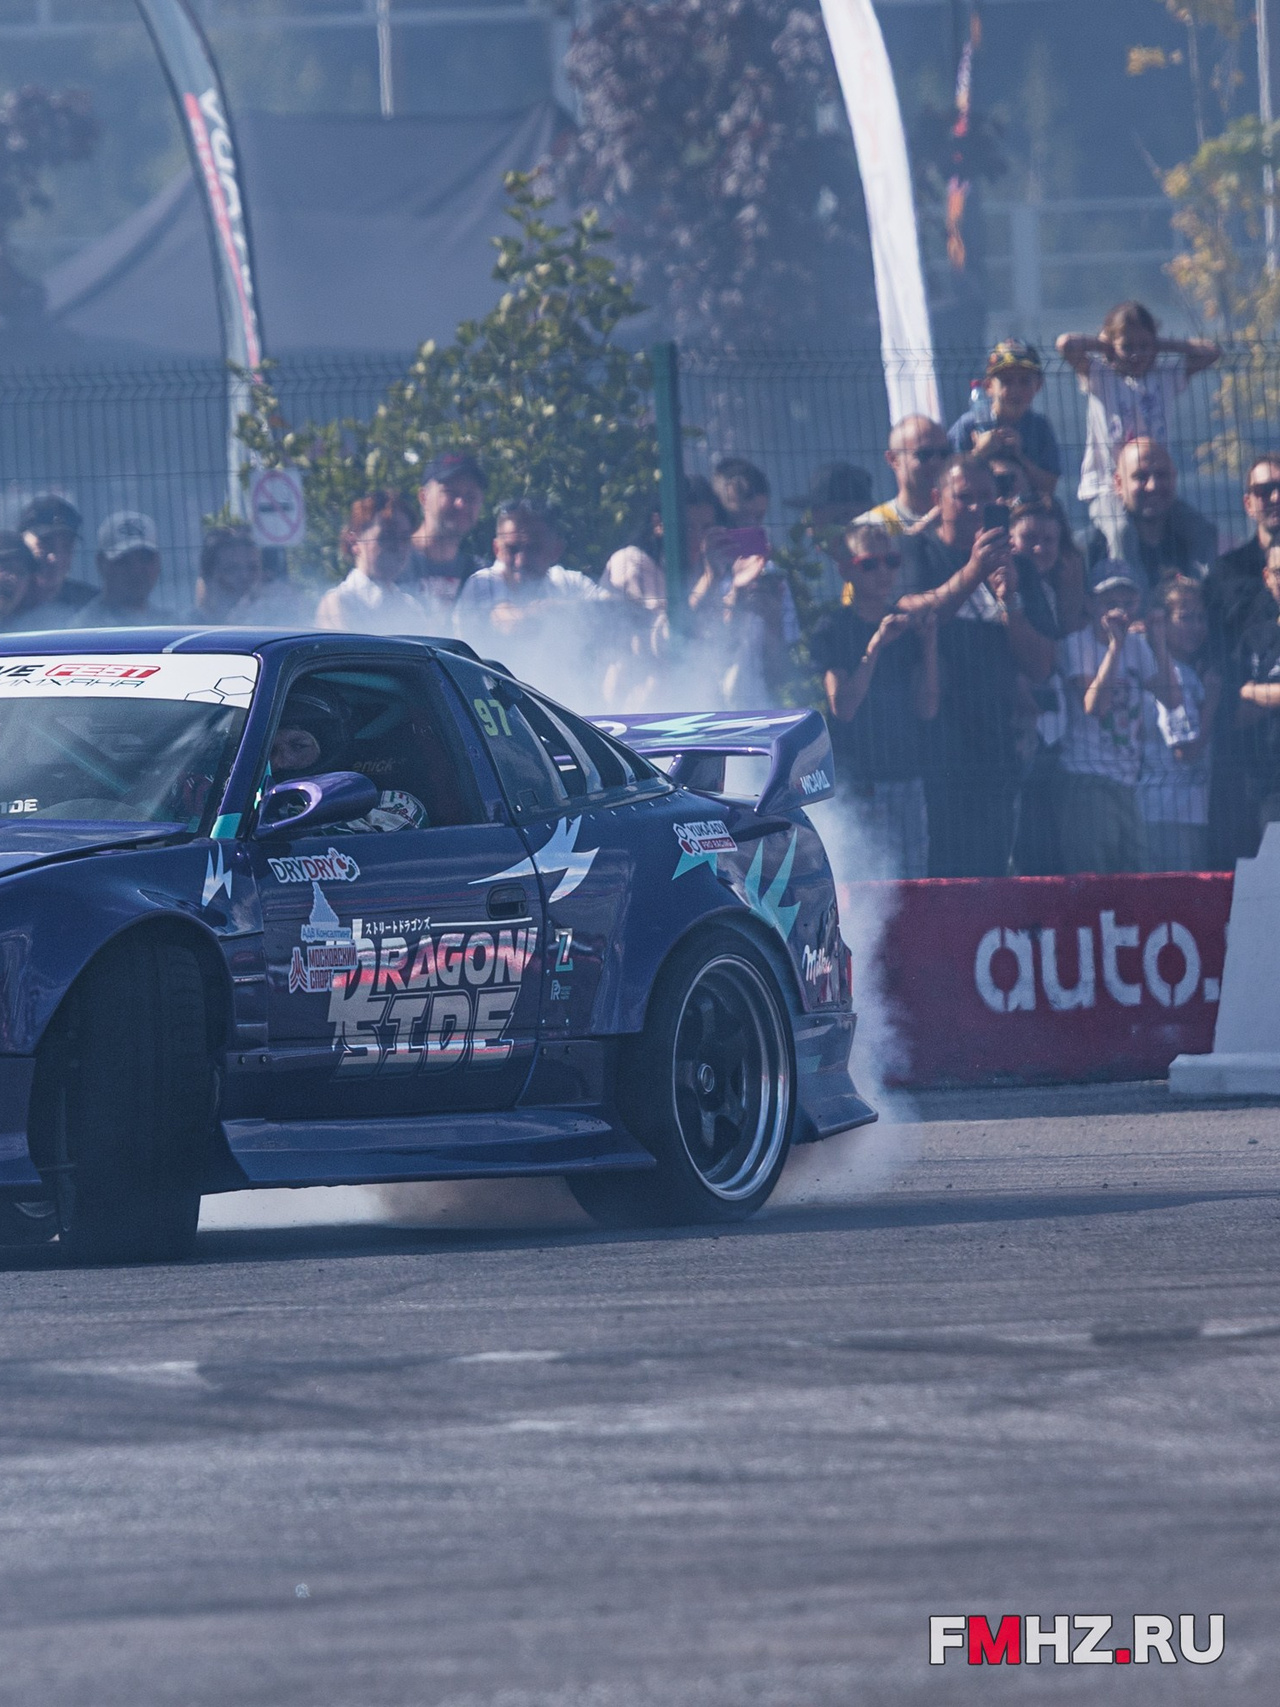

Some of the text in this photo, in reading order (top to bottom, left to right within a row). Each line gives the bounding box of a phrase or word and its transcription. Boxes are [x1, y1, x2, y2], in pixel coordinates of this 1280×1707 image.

[474, 698, 512, 736] 97
[686, 823, 714, 837] YUKA
[271, 858, 338, 881] DRYDRY
[365, 917, 431, 936] ストリートドラゴンズ
[328, 919, 538, 1005] DRAGON
[309, 969, 333, 989] СПОРТ
[331, 984, 521, 1081] SIDE
